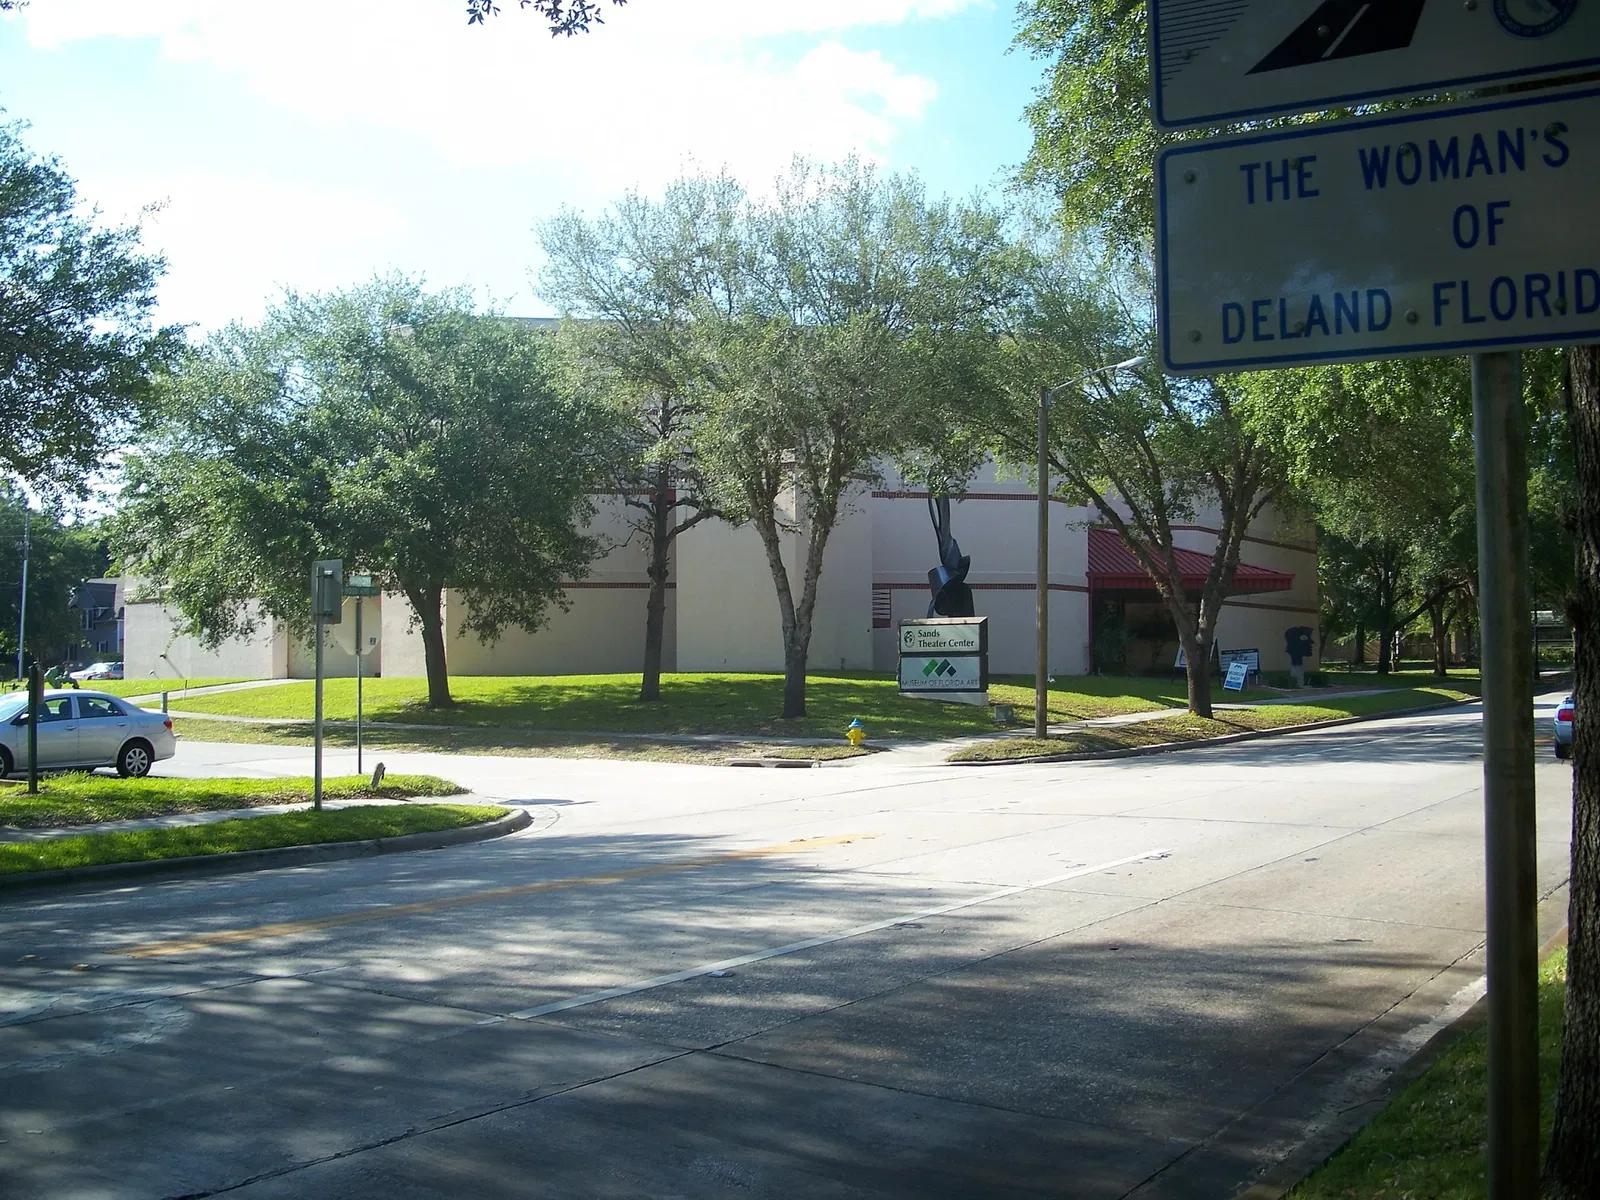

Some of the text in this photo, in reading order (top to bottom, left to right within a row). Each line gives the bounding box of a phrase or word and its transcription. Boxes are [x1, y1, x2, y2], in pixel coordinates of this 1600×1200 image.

[1240, 122, 1570, 204] THE WOMAN'S
[1453, 201, 1511, 249] OF
[1222, 268, 1600, 345] DELAND FLORID
[918, 629, 940, 638] Sands
[918, 639, 975, 648] Theater Center
